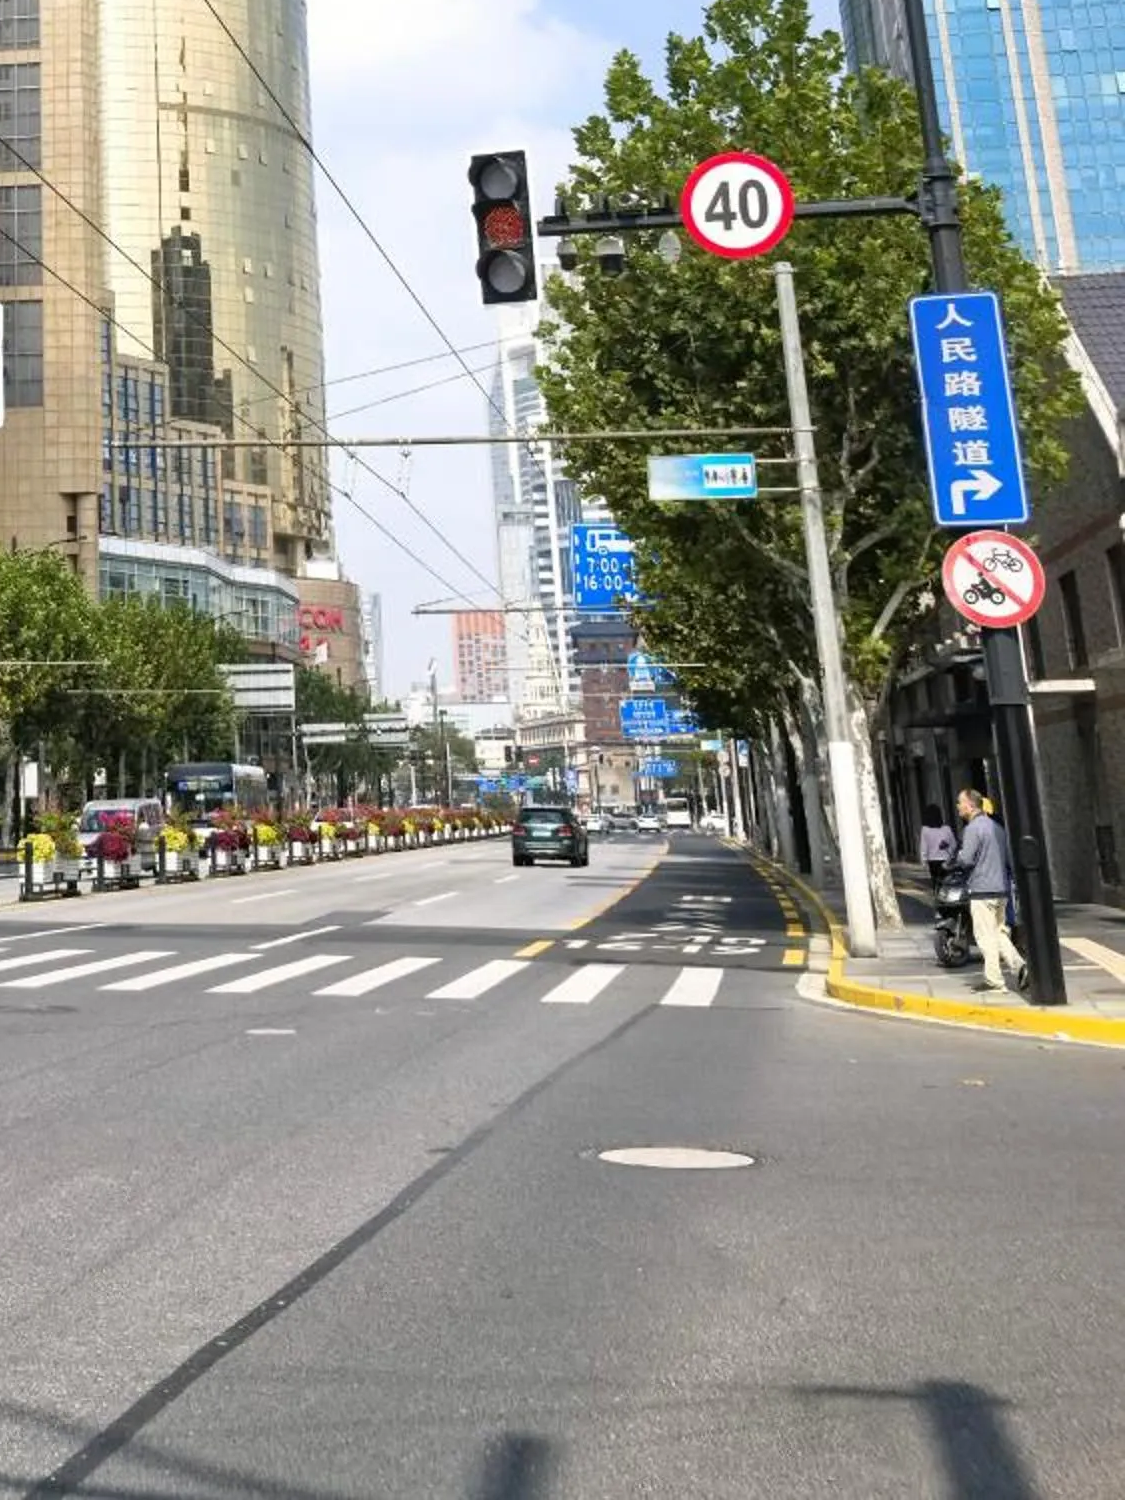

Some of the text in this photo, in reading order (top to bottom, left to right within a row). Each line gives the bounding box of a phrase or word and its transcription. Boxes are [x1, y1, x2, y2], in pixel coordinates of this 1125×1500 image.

[704, 179, 769, 231] 40
[935, 303, 994, 466] 人民路隧道
